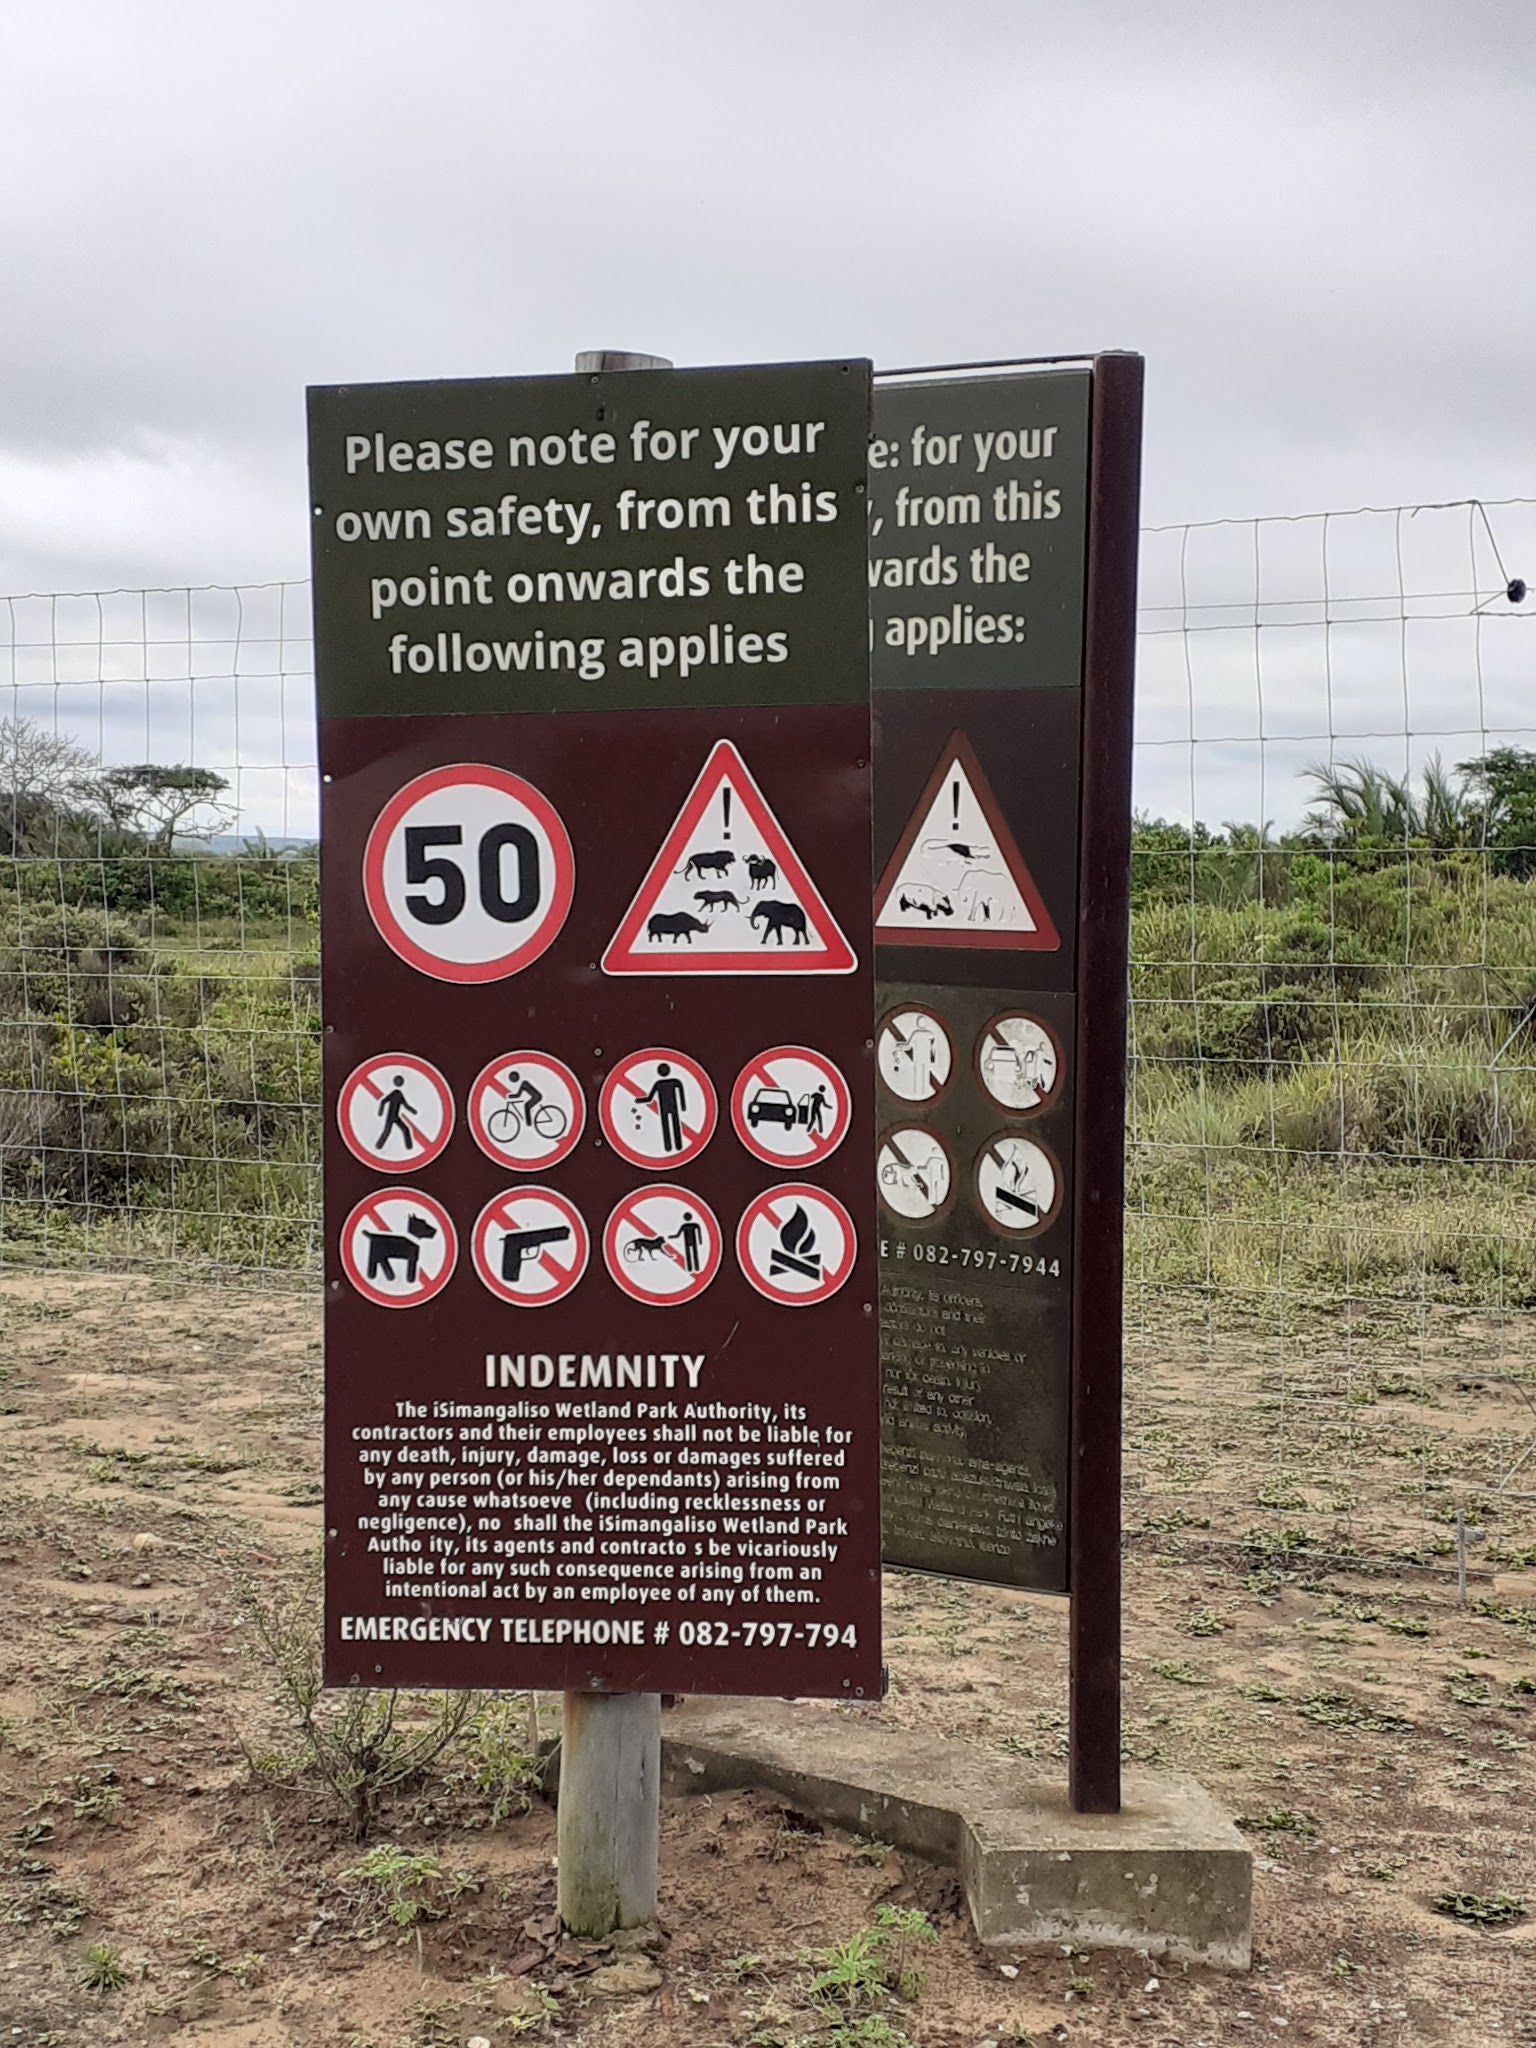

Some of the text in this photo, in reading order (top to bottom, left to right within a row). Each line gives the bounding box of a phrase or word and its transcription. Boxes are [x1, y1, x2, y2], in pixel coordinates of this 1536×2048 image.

[346, 420, 825, 474] Please note for your
[911, 425, 963, 466] for
[973, 427, 1058, 473] your
[336, 509, 431, 542] own
[446, 495, 602, 545] safety,
[616, 489, 731, 531] from
[746, 481, 838, 525] this
[895, 486, 981, 527] from
[992, 479, 1061, 522] this
[969, 542, 1030, 584] the
[371, 553, 804, 619] point onwards the
[885, 604, 1025, 656] applies:
[388, 623, 788, 681] following applies
[405, 822, 540, 925] 50
[896, 1241, 906, 1259] #
[913, 1243, 1060, 1277] 082-797-7944
[486, 1354, 705, 1388] INDEMNITY
[395, 1400, 807, 1424] The iSimangaliso Wetland Park Authority, its
[352, 1423, 853, 1445] contractors and their employees shall not be liable for
[358, 1445, 845, 1470] any death, injury, damage, loss or damages suffered
[364, 1467, 840, 1493] by any person (or his/her dependants) arising from
[378, 1490, 826, 1514] any cause whatsoeve (including recklessness or
[358, 1512, 848, 1537] negligence), no shall the iSimangaliso Wetland Park
[465, 1535, 488, 1553] its
[493, 1538, 555, 1558] agents
[560, 1536, 595, 1554] and
[708, 1538, 731, 1556] be
[736, 1539, 838, 1562] vicariously
[383, 1557, 822, 1584] liable for any such consequence arising from an
[385, 1579, 820, 1606] intentional act by an employee of any of them.
[341, 1616, 857, 1649] EMERGENCY TELEPHONE # 082-797-794
